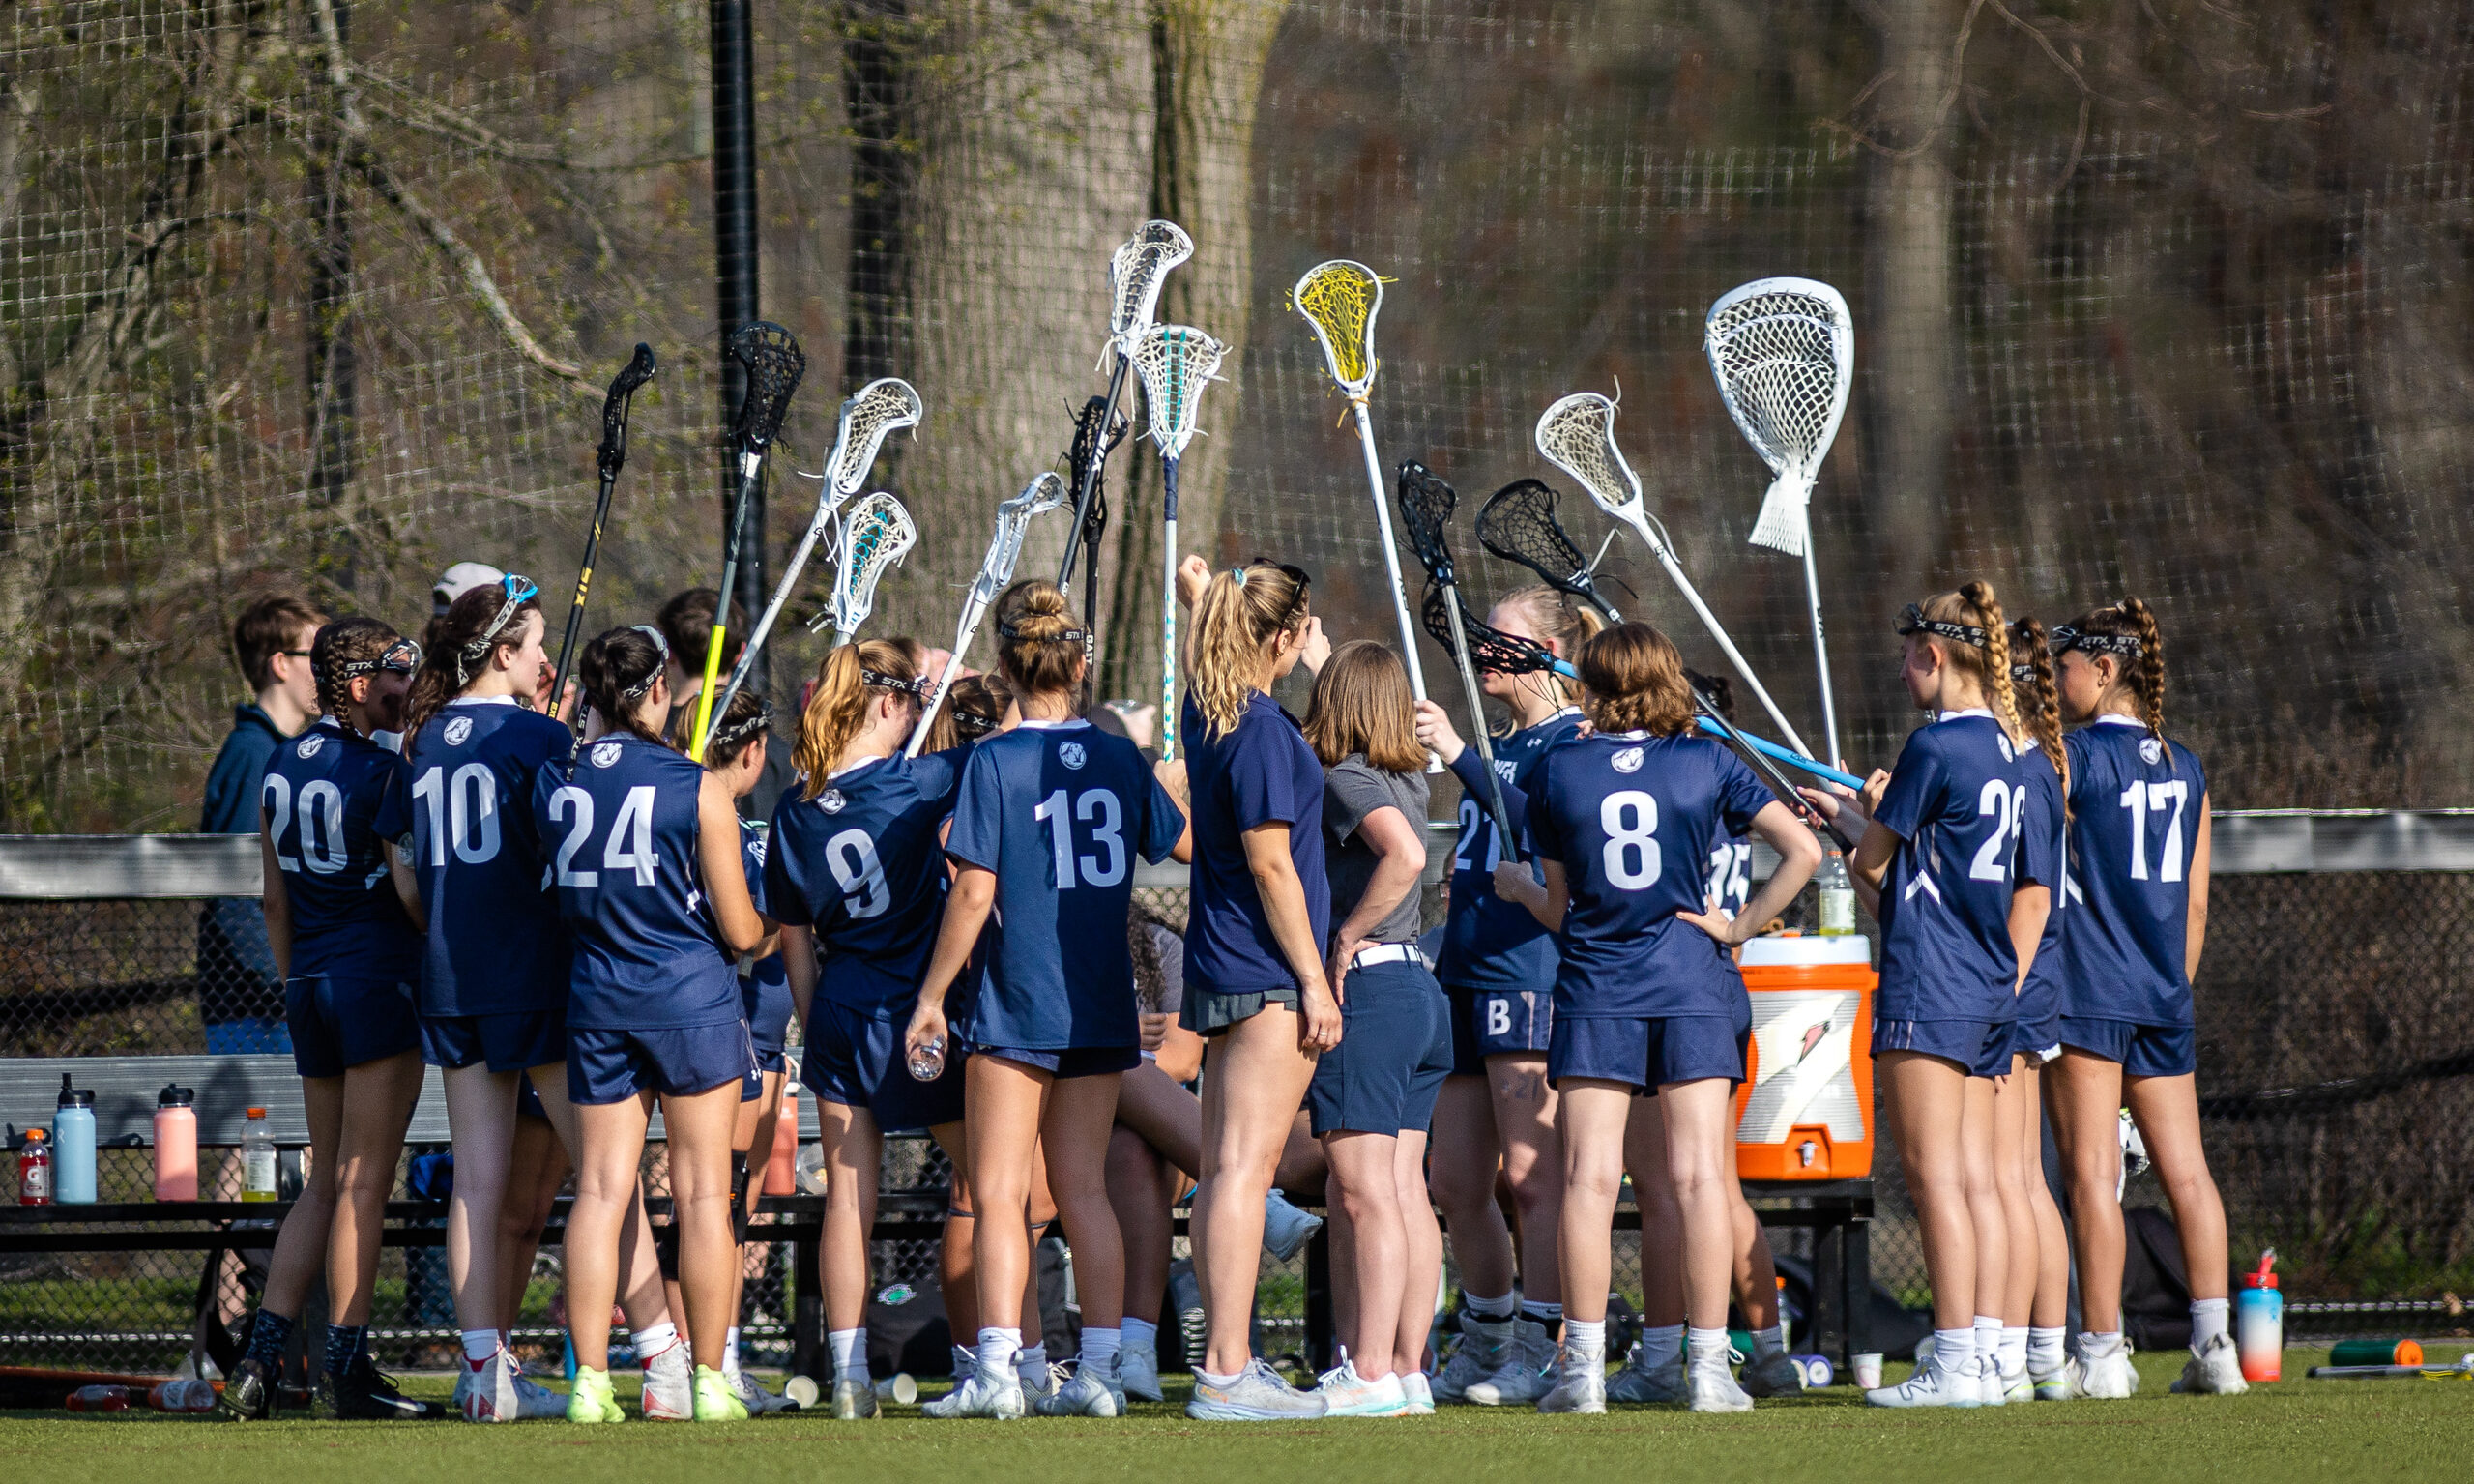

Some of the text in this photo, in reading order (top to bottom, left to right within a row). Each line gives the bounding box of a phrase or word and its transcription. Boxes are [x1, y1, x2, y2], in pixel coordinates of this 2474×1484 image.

[1091, 430, 1110, 472] STX
[573, 567, 593, 607] STX
[1065, 630, 1081, 640] STX
[1935, 622, 1964, 633] STX
[346, 660, 374, 671] STX
[1086, 634, 1094, 666] GAIT
[646, 661, 664, 684] STX
[881, 676, 907, 690] STX
[569, 735, 584, 761] STX
[263, 773, 350, 874] 20
[413, 763, 502, 867] 10
[2120, 780, 2189, 883] 17
[548, 785, 659, 887] 24
[1034, 788, 1126, 889] 13
[1600, 790, 1662, 890] 8
[825, 828, 891, 919] 9
[1487, 998, 1511, 1036] B
[27, 1168, 40, 1181] G
